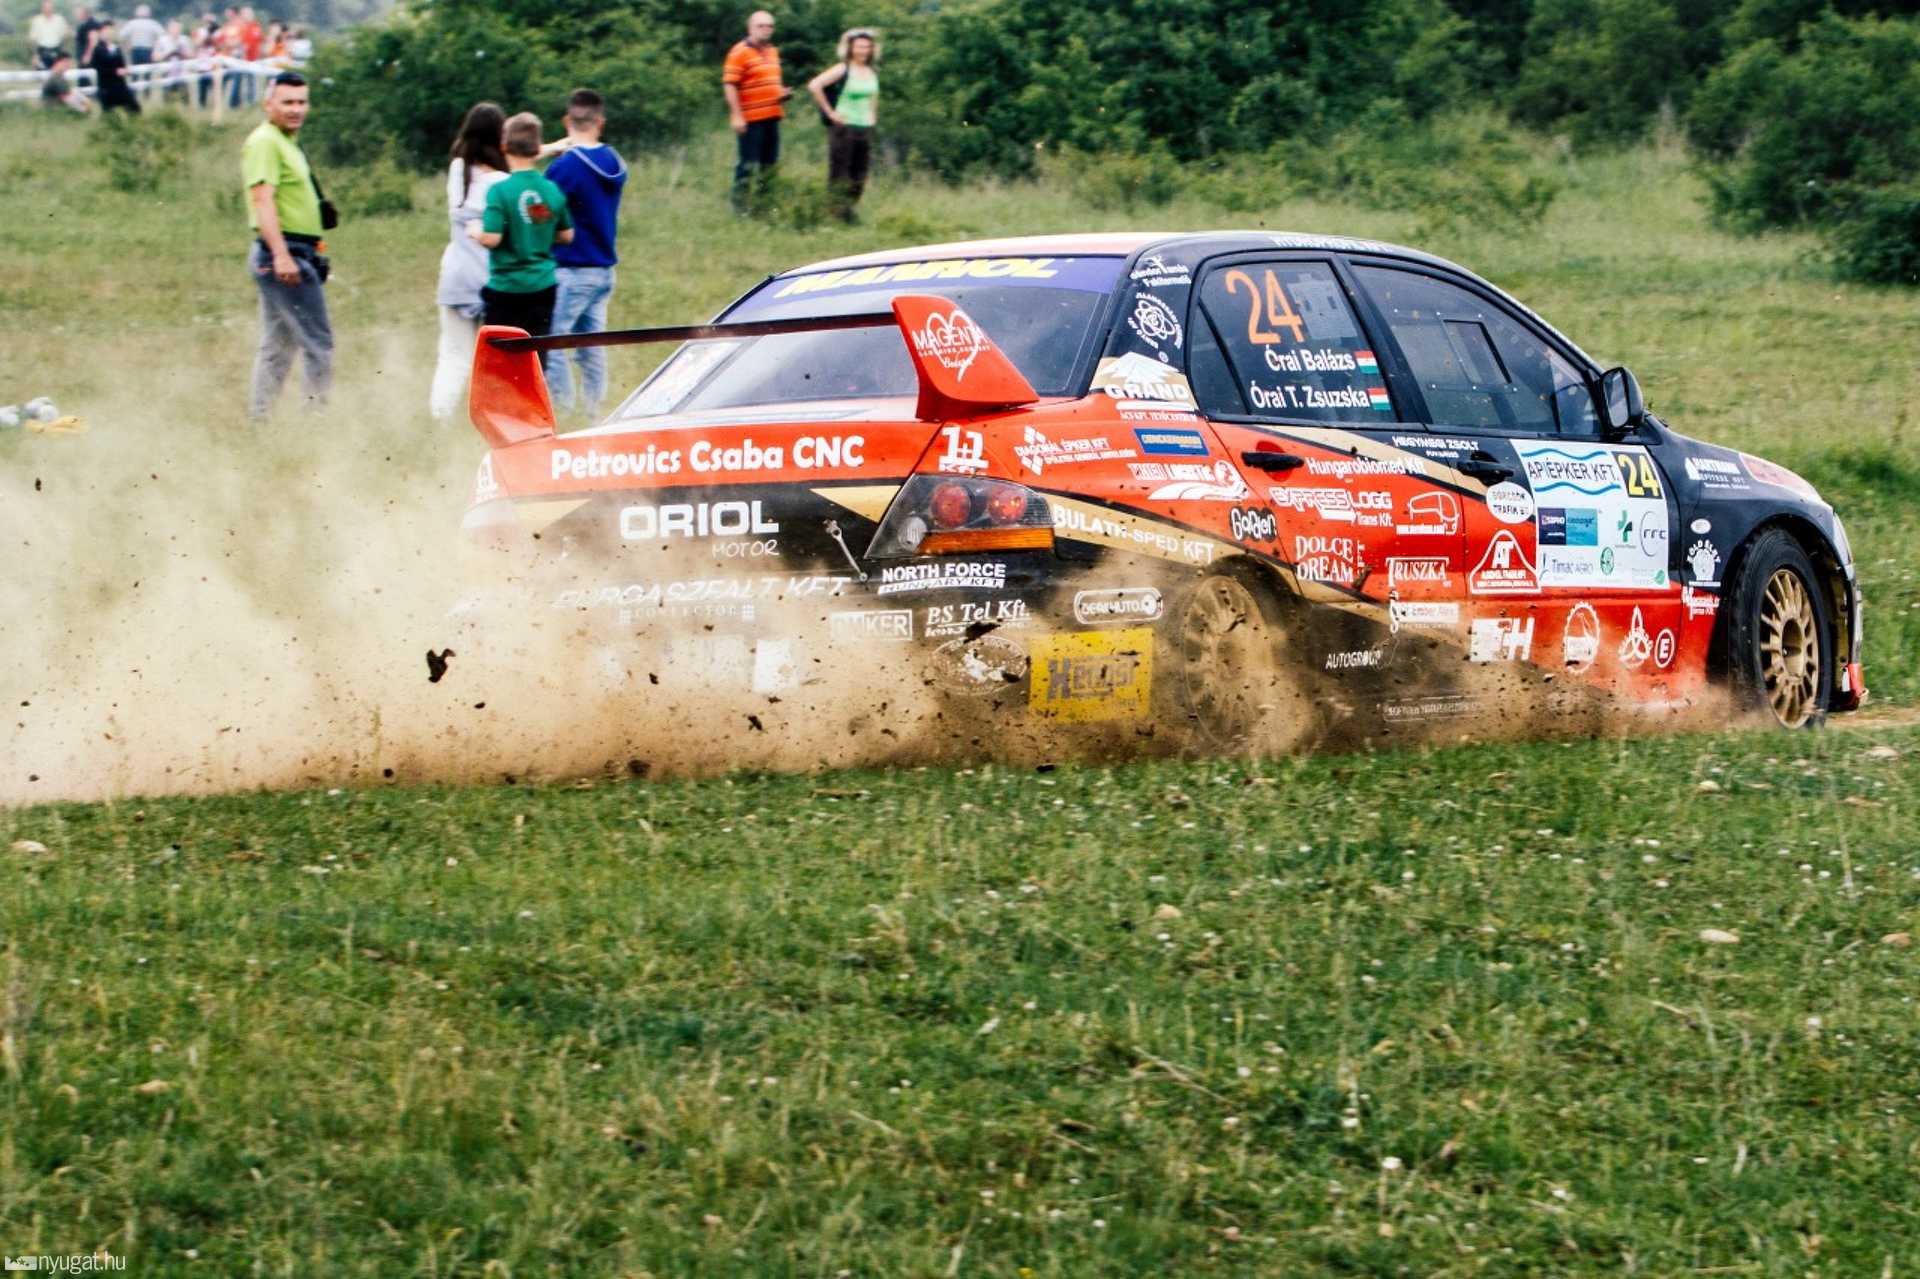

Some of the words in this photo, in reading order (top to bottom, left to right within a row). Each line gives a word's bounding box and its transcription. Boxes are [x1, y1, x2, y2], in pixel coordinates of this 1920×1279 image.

[1224, 268, 1306, 345] 24
[911, 323, 989, 350] MAGENTA
[1264, 344, 1300, 371] Órai
[1300, 348, 1356, 372] Balázs
[1104, 383, 1190, 400] GRAND
[1250, 380, 1286, 408] Órai
[1285, 386, 1305, 409] T.
[1304, 385, 1371, 408] Zsuzska
[551, 445, 681, 480] Petrovics
[689, 439, 784, 472] Csaba
[793, 436, 865, 469] CNC
[1305, 456, 1406, 479] Hungarobiomed
[1618, 454, 1660, 497] 24
[1268, 487, 1350, 512] EXPRESS
[1348, 490, 1393, 510] LOGG
[619, 500, 780, 540] ORIOL
[711, 539, 780, 558] MOTOR
[1183, 540, 1215, 566] KFT
[1295, 535, 1354, 563] DOLCE
[881, 564, 940, 584] NORTH
[945, 562, 1006, 578] FORCE
[1296, 556, 1354, 583] DREAM
[926, 605, 954, 625] BS
[960, 600, 990, 622] Tel
[997, 598, 1030, 618] Kft.
[1325, 649, 1383, 670] AUTOGROUP
